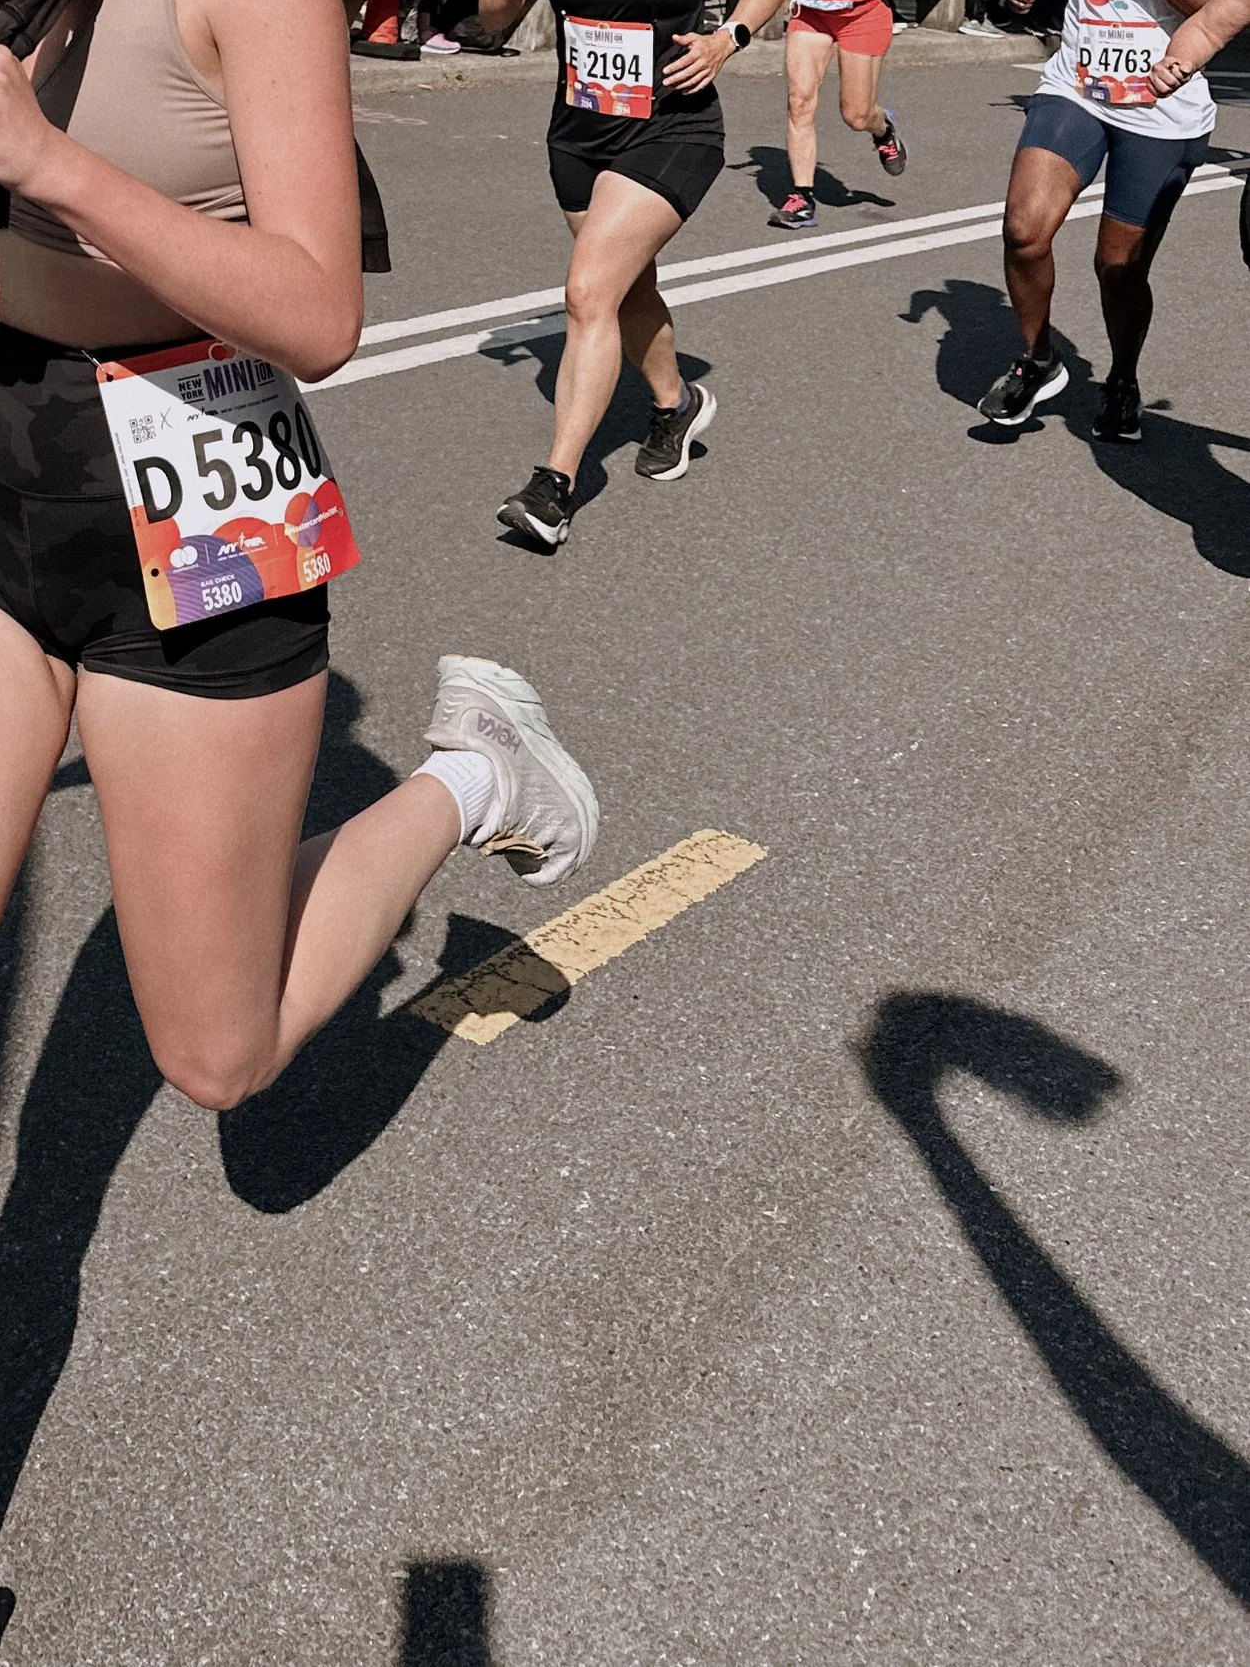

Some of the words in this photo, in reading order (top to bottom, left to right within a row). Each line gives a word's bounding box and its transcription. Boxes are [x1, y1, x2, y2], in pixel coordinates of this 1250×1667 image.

[569, 46, 579, 70] E
[587, 50, 642, 82] 2194
[1080, 48, 1092, 67] D
[1098, 48, 1152, 73] 4763
[178, 378, 202, 392] NEW
[203, 359, 256, 402] MINI
[180, 388, 204, 401] YORK
[133, 456, 183, 524] D
[192, 401, 321, 511] 5380
[303, 552, 332, 583] 5380
[201, 581, 243, 611] 5380
[476, 712, 522, 755] HOKA
